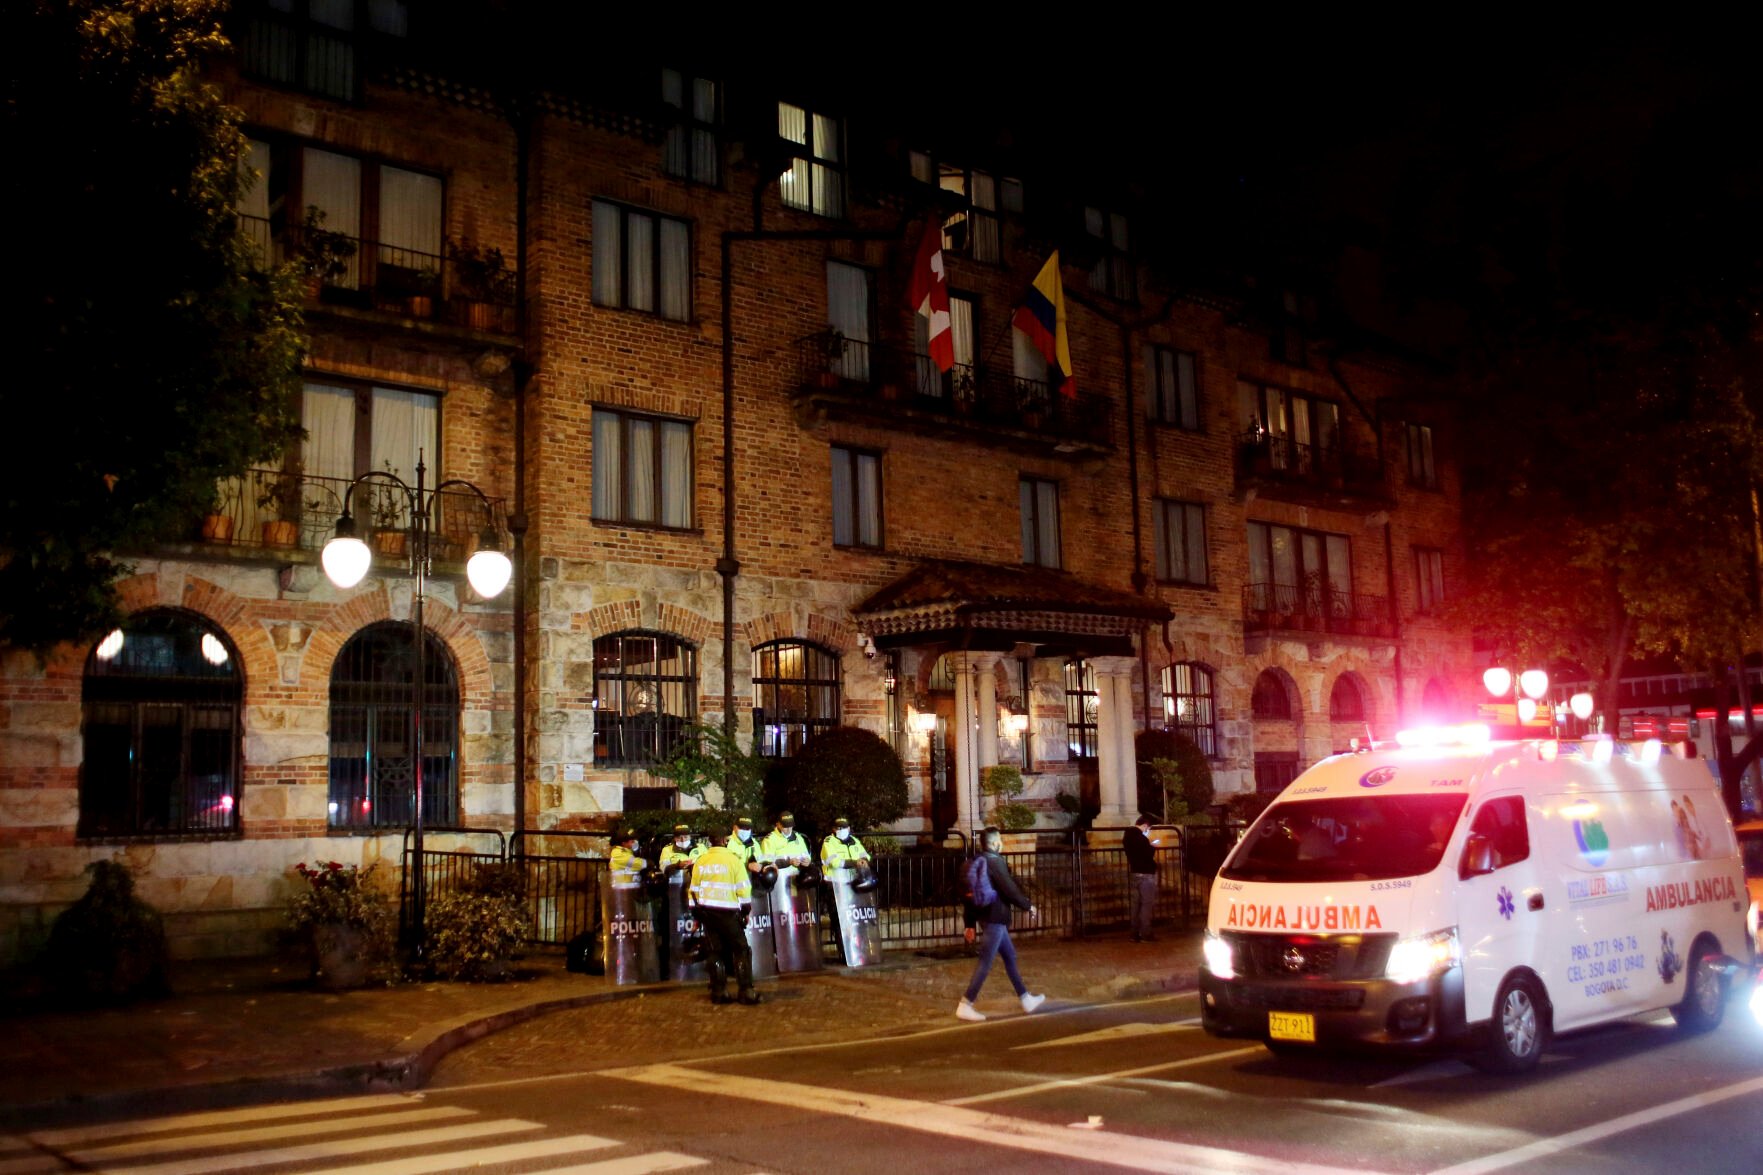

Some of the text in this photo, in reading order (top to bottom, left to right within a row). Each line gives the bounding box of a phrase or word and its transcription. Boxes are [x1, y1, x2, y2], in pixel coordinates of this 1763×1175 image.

[1646, 876, 1736, 912] AMBULANCIA
[780, 912, 816, 927] POLICIA
[845, 907, 877, 921] POLICIA
[610, 920, 654, 935] POLICIA
[1594, 940, 1610, 957] 271
[1292, 1016, 1312, 1034] 911
